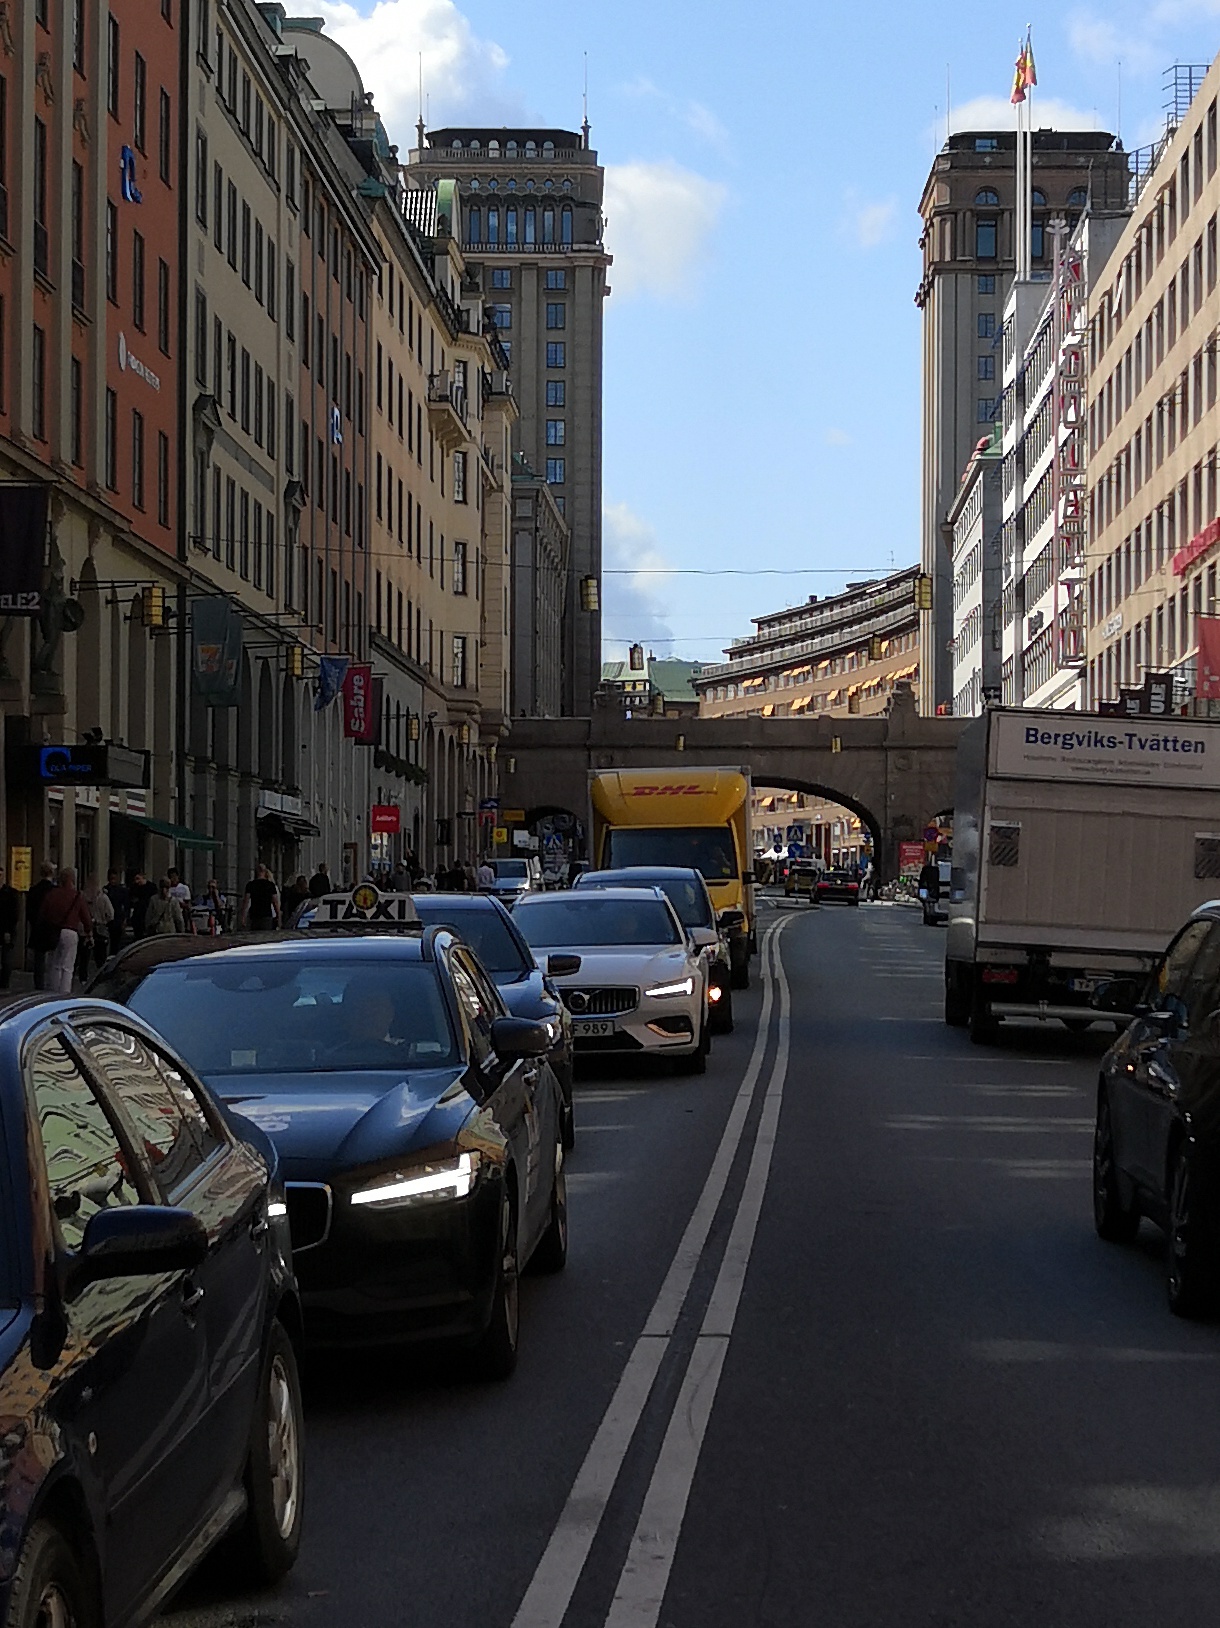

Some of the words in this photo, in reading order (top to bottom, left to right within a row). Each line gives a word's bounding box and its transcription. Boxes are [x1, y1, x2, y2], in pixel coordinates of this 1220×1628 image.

[0, 591, 41, 609] ELE2
[350, 674, 366, 732] Sabre
[1025, 727, 1206, 754] Bergviks-Tvätten
[633, 785, 704, 796] DHL
[322, 899, 406, 920] TAXI
[583, 1023, 608, 1034] 989
